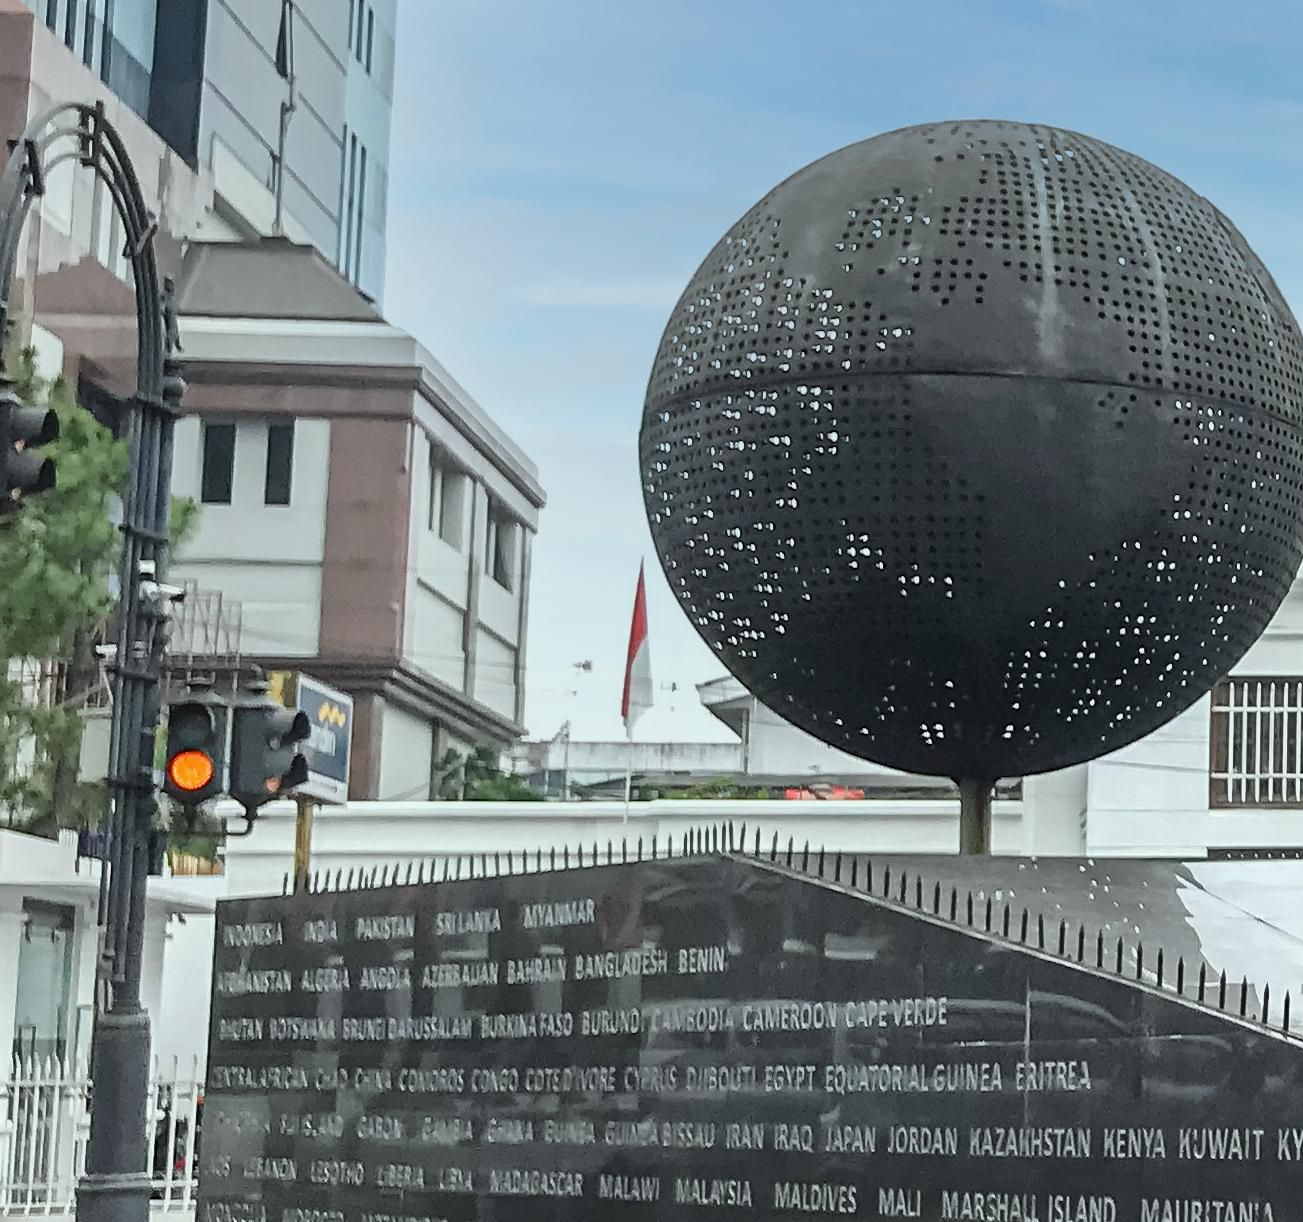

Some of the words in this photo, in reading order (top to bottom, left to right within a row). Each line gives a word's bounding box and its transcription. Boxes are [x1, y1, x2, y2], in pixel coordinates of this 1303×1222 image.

[356, 914, 415, 940] PAKISTAN
[523, 898, 596, 929] MYANMAR
[507, 956, 567, 985] BAHRAIN
[575, 951, 669, 981] BANGLADESH
[678, 946, 726, 974] BENIN
[538, 1011, 574, 1037] FASO
[581, 1007, 645, 1037] BURUNDI
[742, 1001, 837, 1031] CAMEROON
[846, 999, 888, 1028] CAPE
[892, 996, 948, 1026] VERDE
[764, 1064, 816, 1093] EGYPT
[824, 1062, 930, 1095] EQUATORIAL
[932, 1062, 1002, 1092] GUINEA
[1015, 1059, 1092, 1092] ERITREA
[726, 1122, 765, 1150] IRAN
[774, 1122, 814, 1153] IRAQ
[825, 1125, 876, 1153] JAPAN
[887, 1126, 958, 1155] JORDAN
[968, 1126, 1092, 1158] KAZAKHSTAN
[1103, 1127, 1167, 1160] KENYA
[1178, 1126, 1265, 1161] KUWAIT
[599, 1172, 660, 1201] MALAWI
[674, 1177, 752, 1207] MALAYSIA
[774, 1180, 858, 1214] MALDIVES
[878, 1187, 922, 1217] MALI
[941, 1191, 1040, 1222] MARSHALL
[1048, 1194, 1117, 1222] ISLAND
